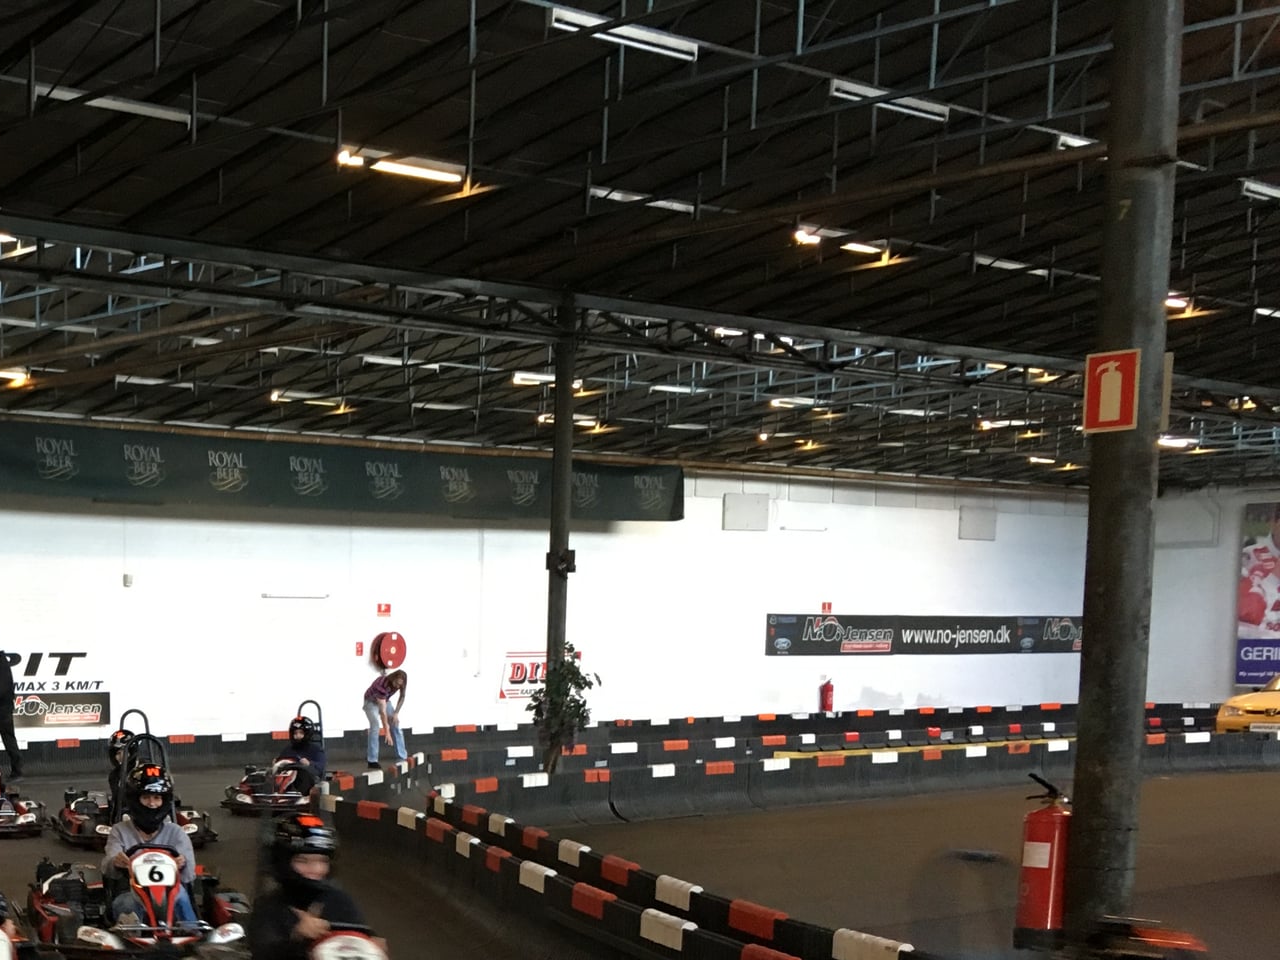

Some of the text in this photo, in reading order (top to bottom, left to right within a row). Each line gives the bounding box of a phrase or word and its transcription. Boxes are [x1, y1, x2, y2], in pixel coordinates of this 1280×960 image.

[35, 437, 78, 456] ROYAL
[124, 444, 165, 463] ROYAL
[46, 453, 72, 468] BEER
[208, 450, 248, 468] ROYAL
[289, 456, 327, 473] ROYAL
[134, 460, 159, 475] BEER
[216, 466, 241, 480] BEER
[365, 461, 402, 477] ROYAL
[634, 475, 665, 489] ROYAL
[841, 626, 893, 641] Jensen
[902, 625, 1011, 648] www.no-jensen.dk
[51, 681, 61, 691] 3
[65, 680, 104, 691] KM/T
[47, 702, 102, 716] Jensen
[148, 866, 164, 883] 6
